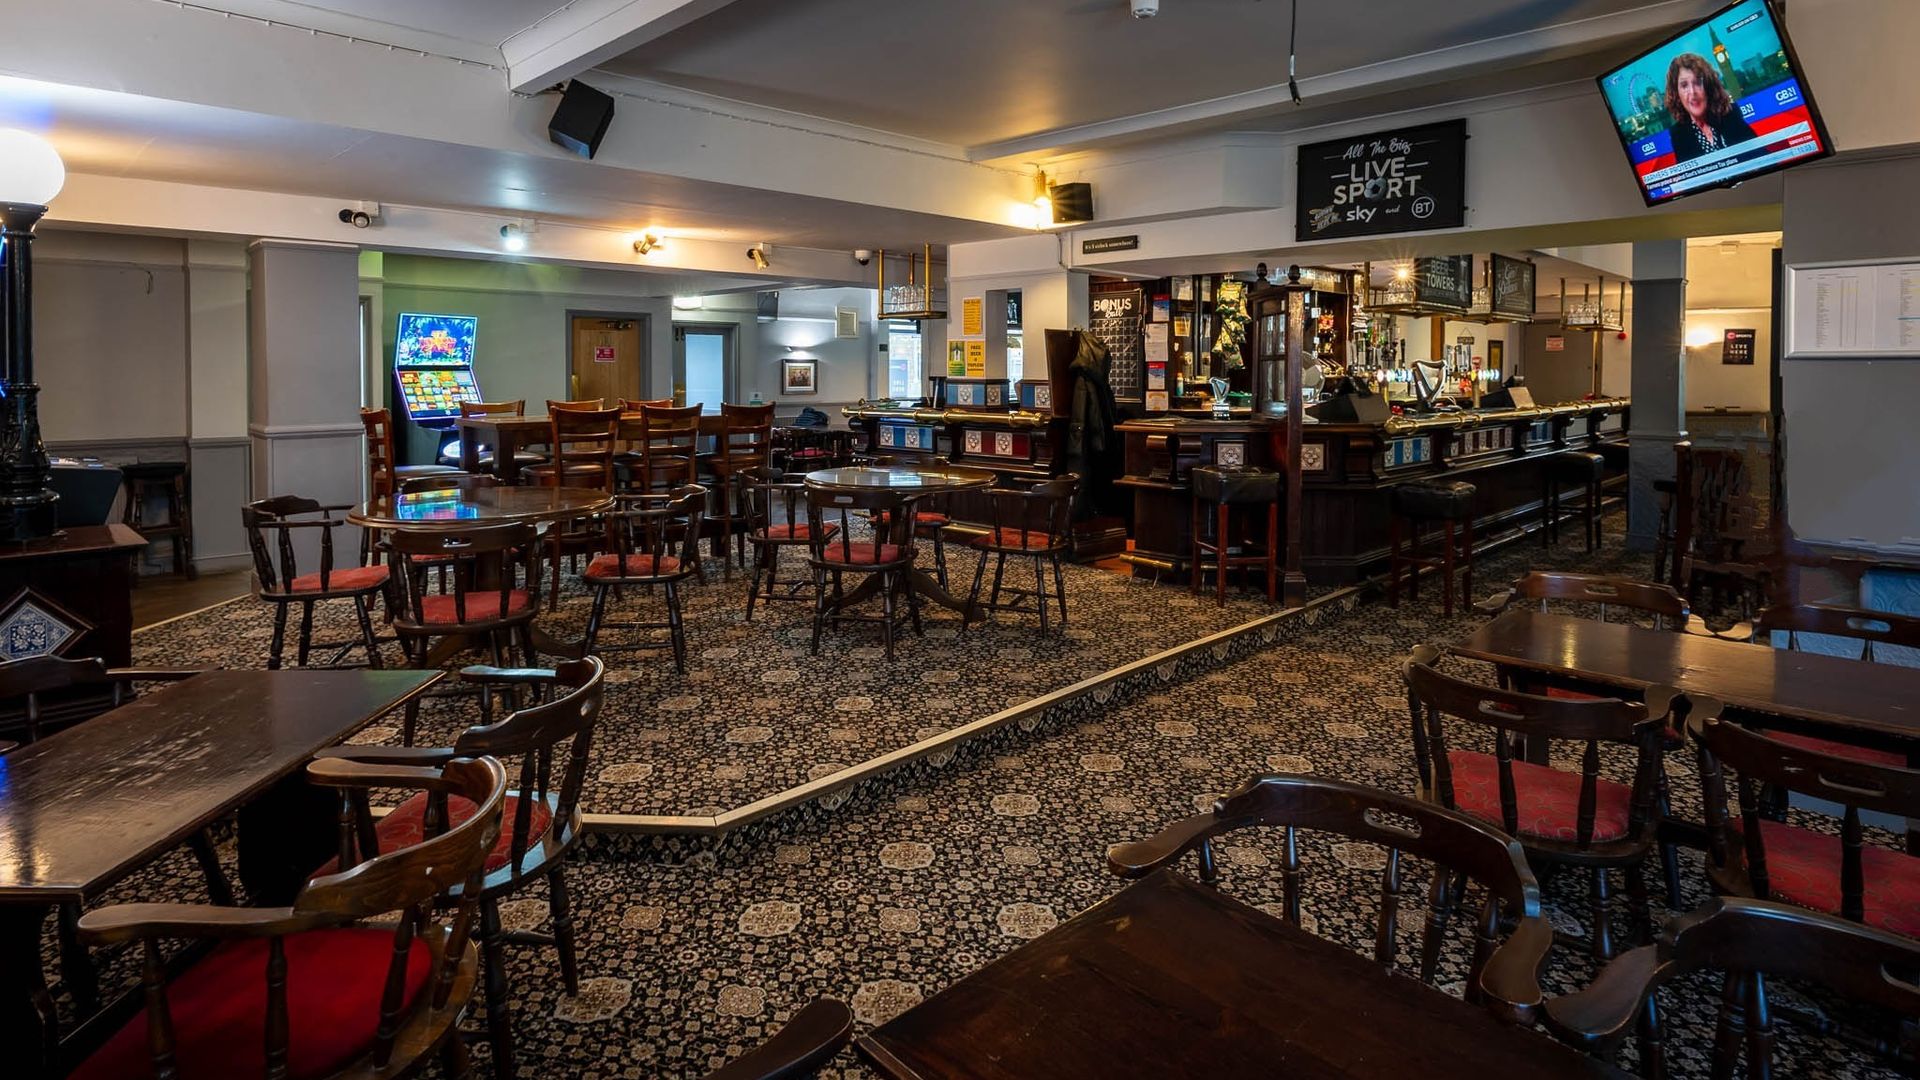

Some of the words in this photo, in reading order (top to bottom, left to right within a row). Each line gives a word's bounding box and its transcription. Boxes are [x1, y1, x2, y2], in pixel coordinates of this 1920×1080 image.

[1741, 103, 1753, 116] BN
[1343, 144, 1364, 160] All
[1370, 141, 1386, 156] The
[1389, 138, 1413, 154] Big
[1351, 157, 1405, 183] LIVE
[1669, 159, 1699, 174] PROTESTS
[1333, 175, 1422, 205] SPORT
[1346, 205, 1377, 223] sky
[1415, 202, 1431, 213] BT
[1431, 260, 1449, 276] BEER
[1426, 273, 1454, 291] TOWERS
[1093, 298, 1132, 312] BONUS
